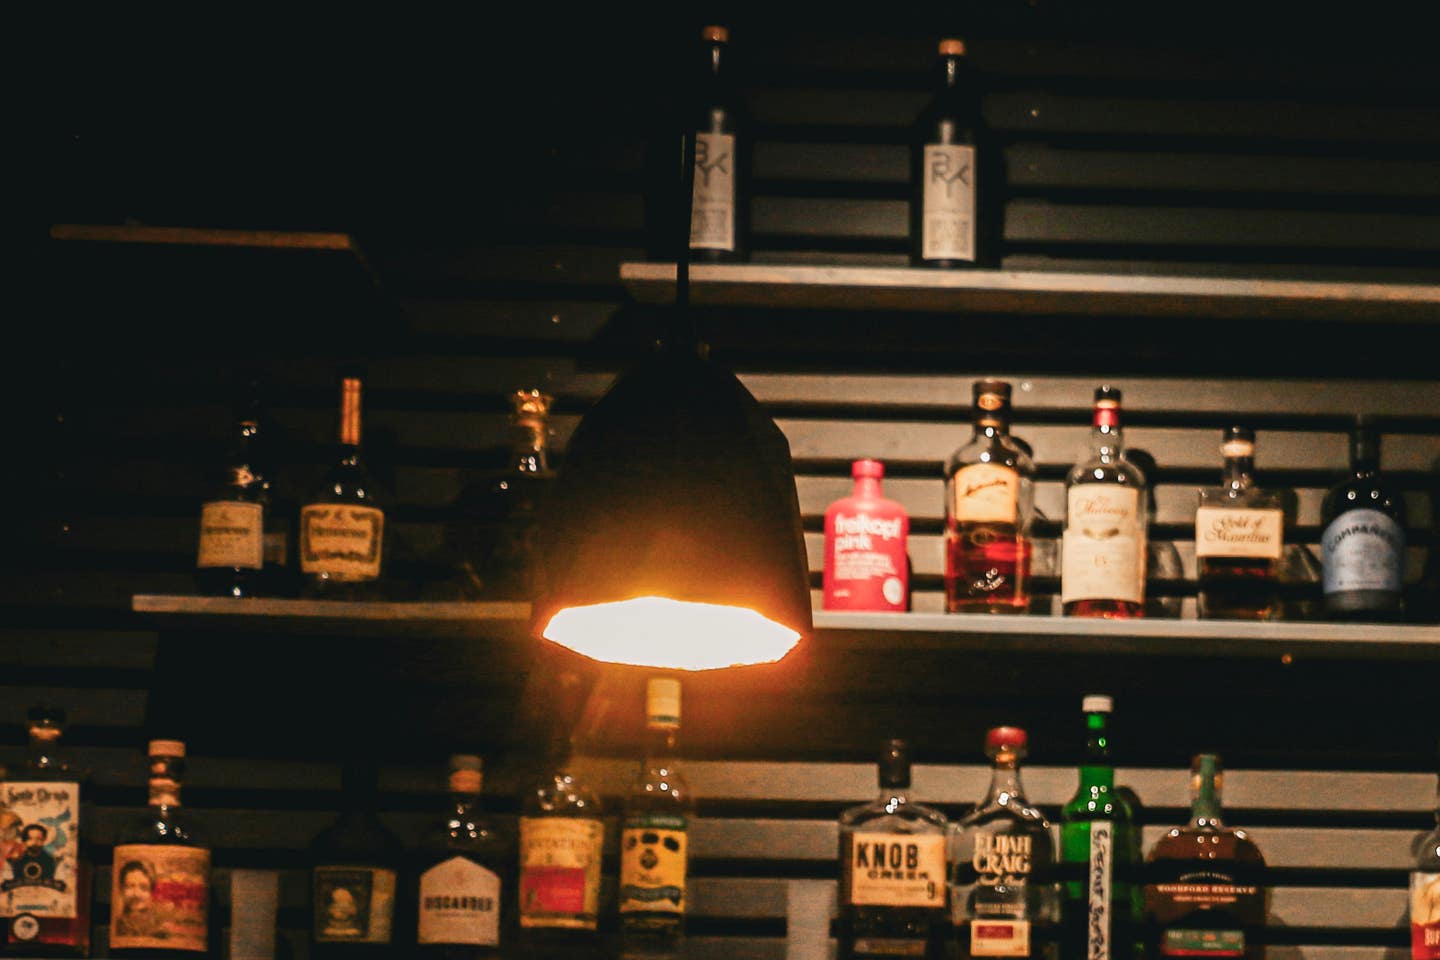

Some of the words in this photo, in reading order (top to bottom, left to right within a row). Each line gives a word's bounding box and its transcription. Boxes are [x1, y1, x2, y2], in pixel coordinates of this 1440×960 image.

[857, 842, 919, 869] KNOB
[972, 853, 1032, 876] CRAIG
[867, 871, 929, 881] CREEK
[926, 880, 936, 900] 9
